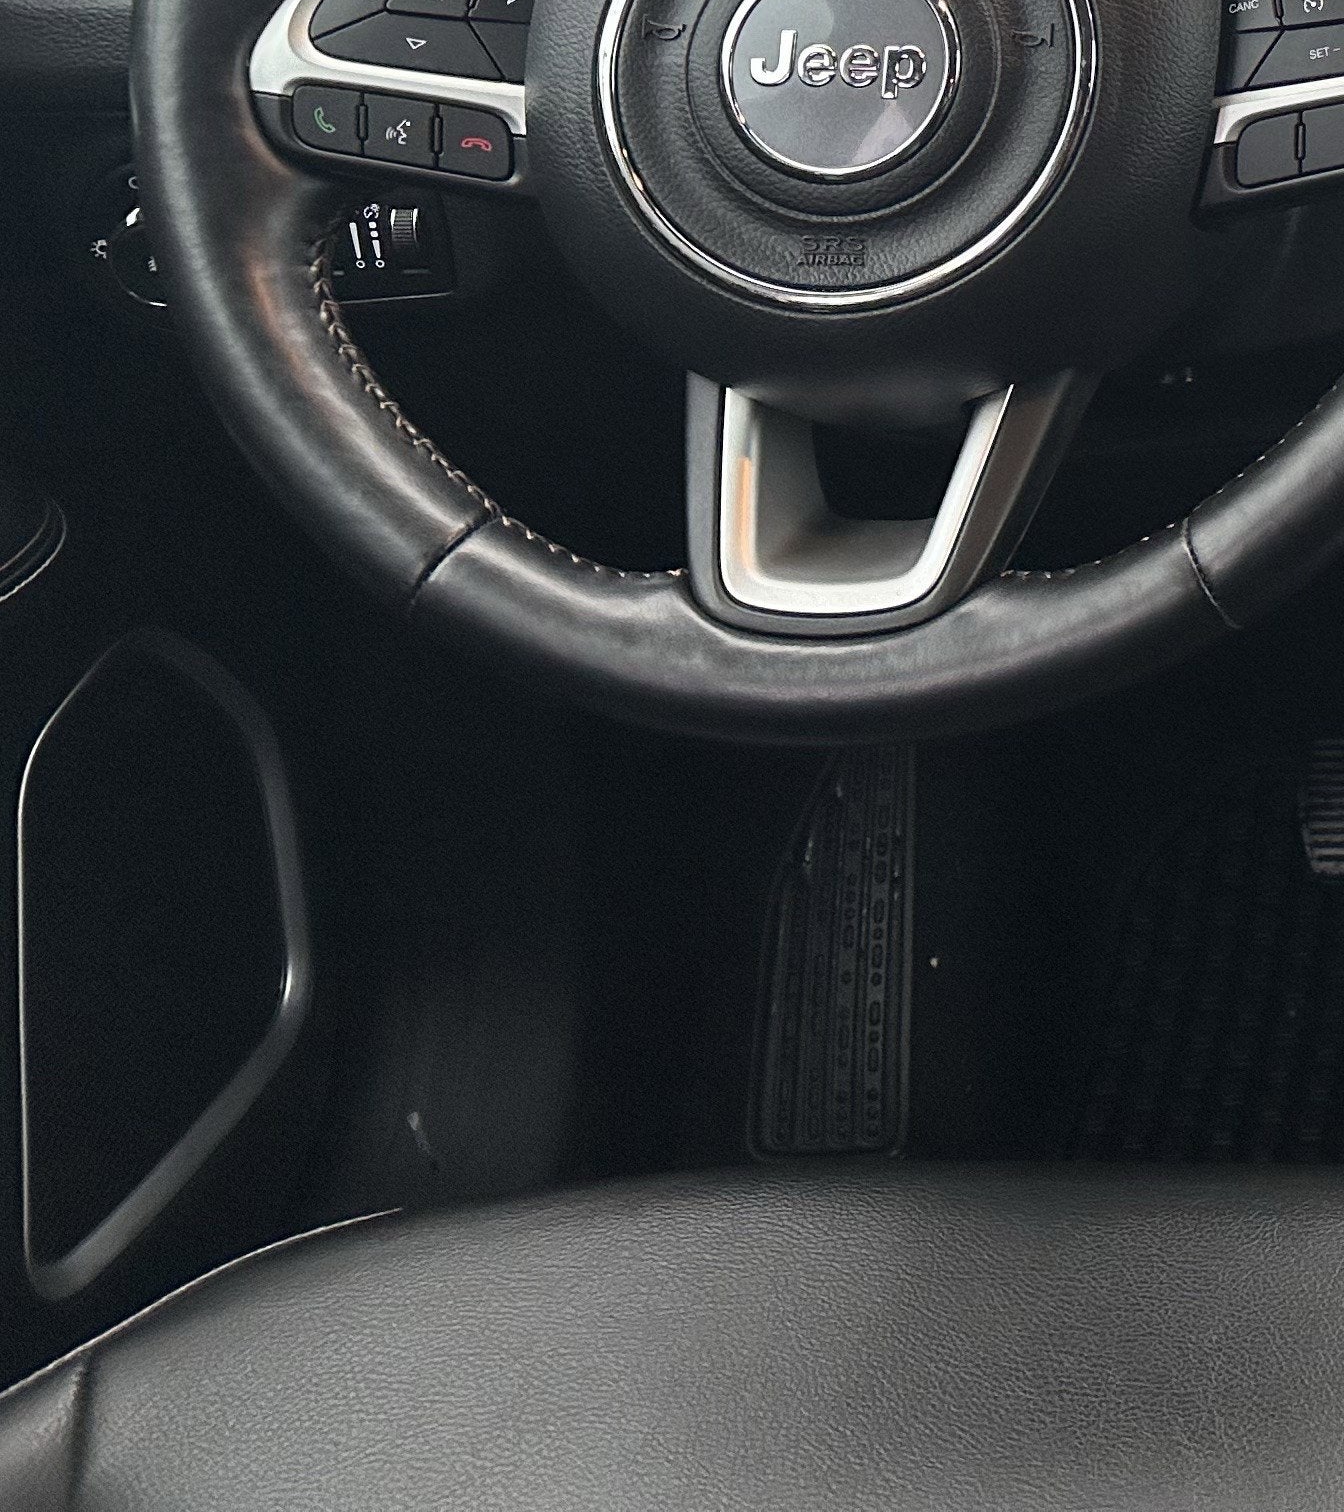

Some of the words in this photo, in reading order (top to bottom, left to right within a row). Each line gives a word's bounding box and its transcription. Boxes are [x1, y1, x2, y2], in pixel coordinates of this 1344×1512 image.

[1309, 47, 1330, 60] SET
[748, 28, 928, 99] Jeep
[801, 235, 864, 251] SRS
[797, 254, 864, 266] AIRBAG
